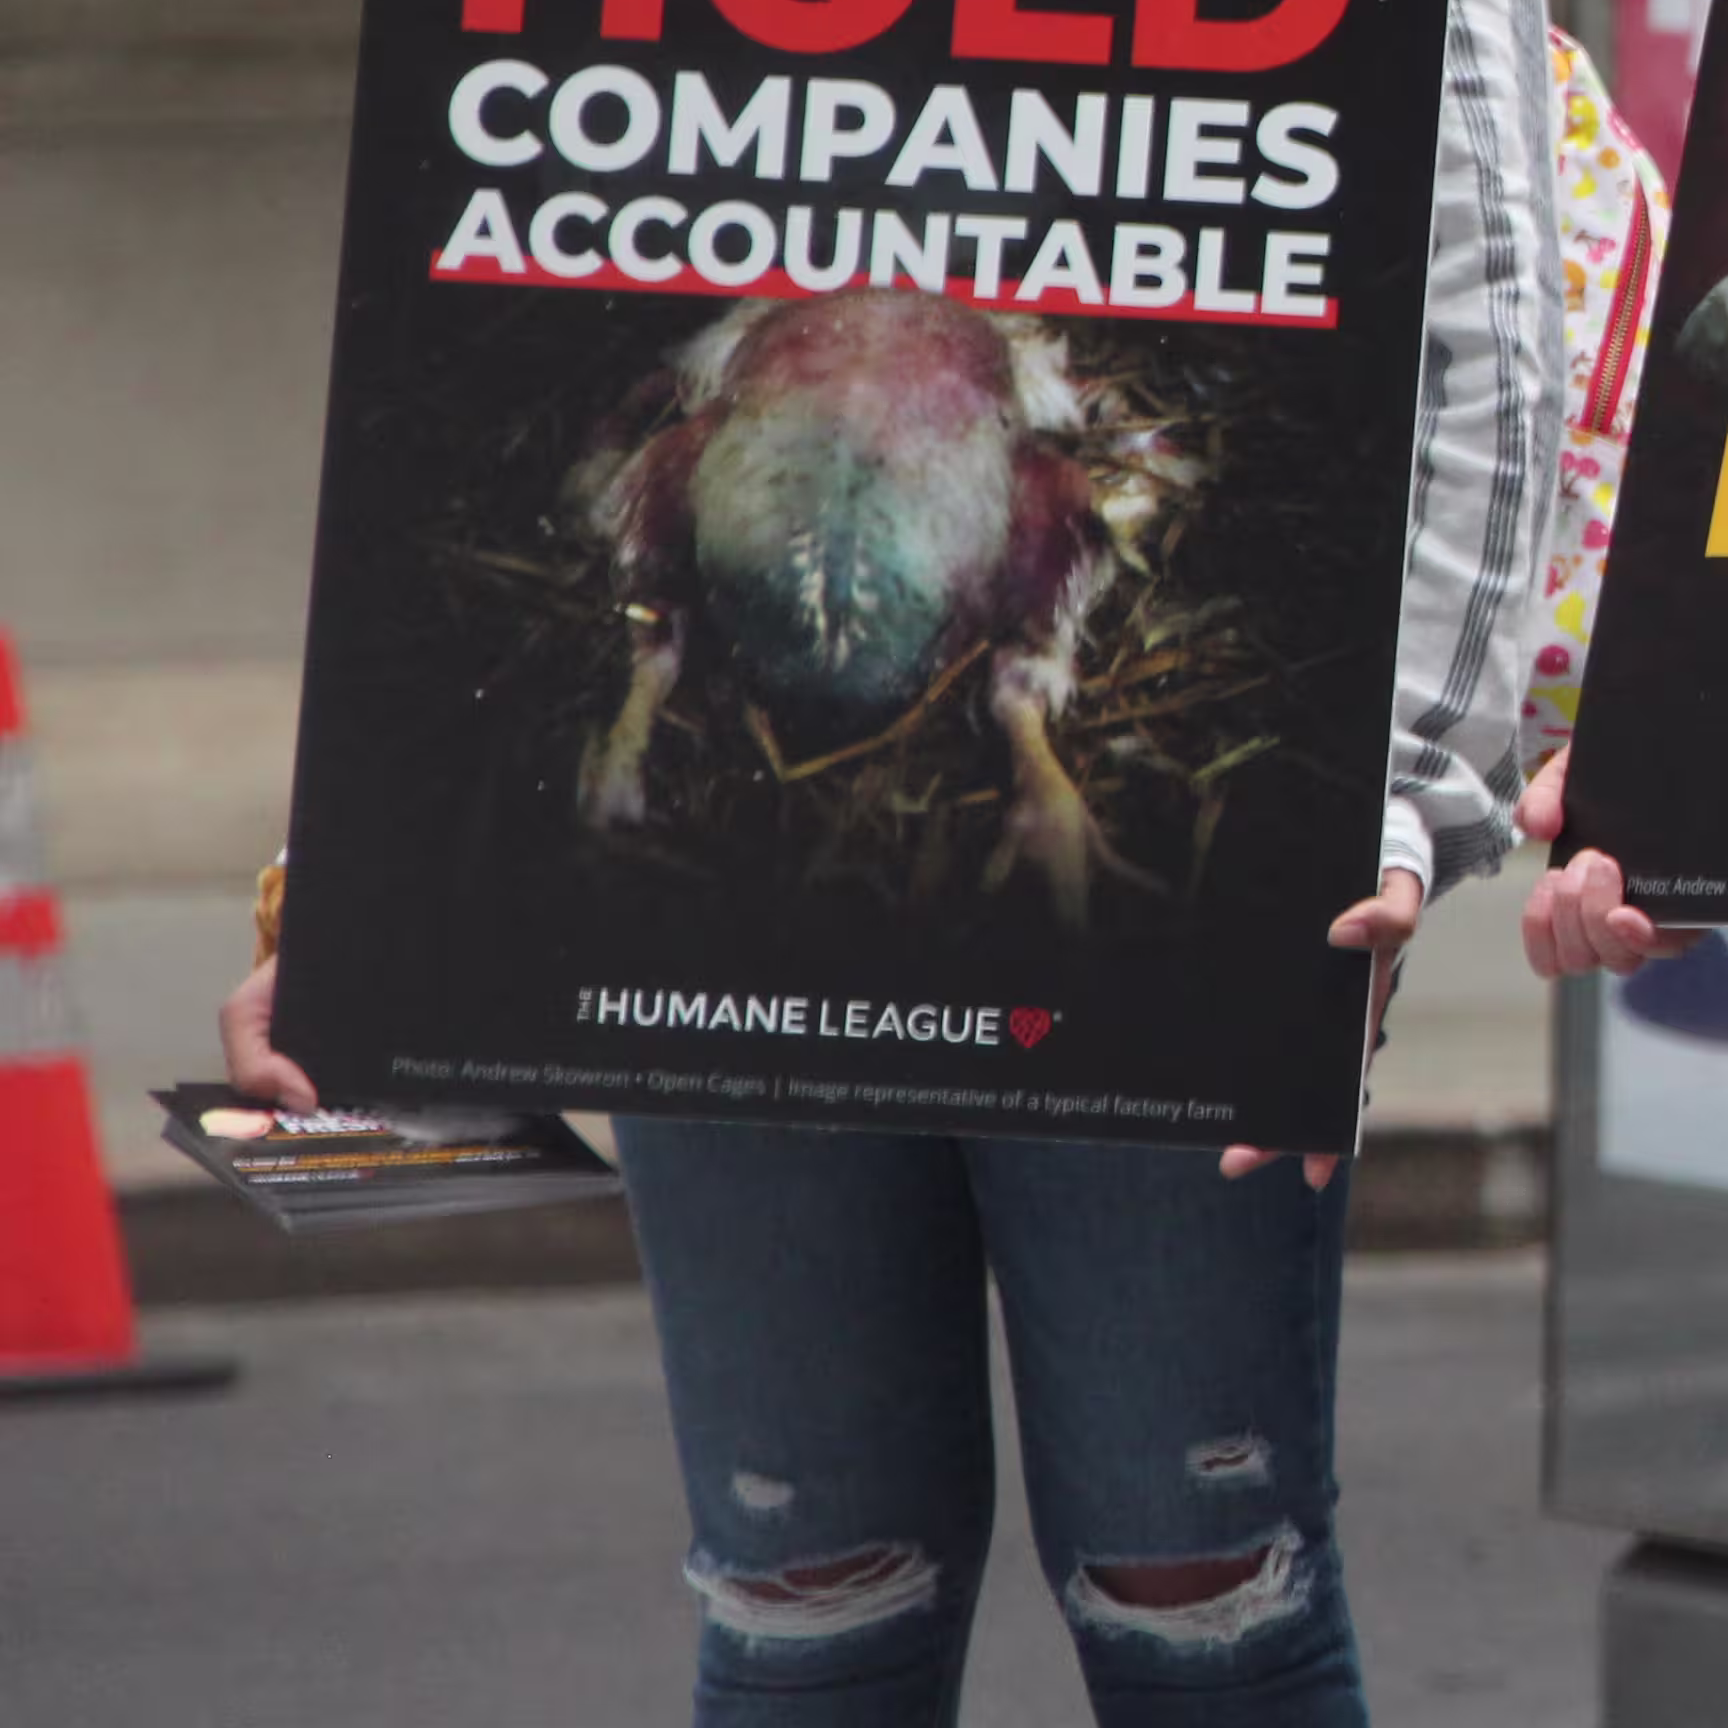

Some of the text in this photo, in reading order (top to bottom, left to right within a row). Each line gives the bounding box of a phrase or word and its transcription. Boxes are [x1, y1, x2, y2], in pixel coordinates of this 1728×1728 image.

[447, 58, 1341, 210] COMPANIES
[436, 188, 1332, 316] ACCOUNTABLE
[1673, 877, 1726, 896] Andrew
[597, 987, 808, 1035] HUMANE
[819, 998, 1002, 1046] LEAGUE
[461, 1060, 538, 1083] Andrew
[647, 1069, 701, 1093] Open
[788, 1074, 847, 1103] Image
[854, 1083, 997, 1109] representative
[1001, 1088, 1025, 1109] of
[1027, 1094, 1039, 1111] a
[1044, 1091, 1108, 1118] typical
[1113, 1094, 1180, 1122] factory
[1186, 1097, 1234, 1121] farm
